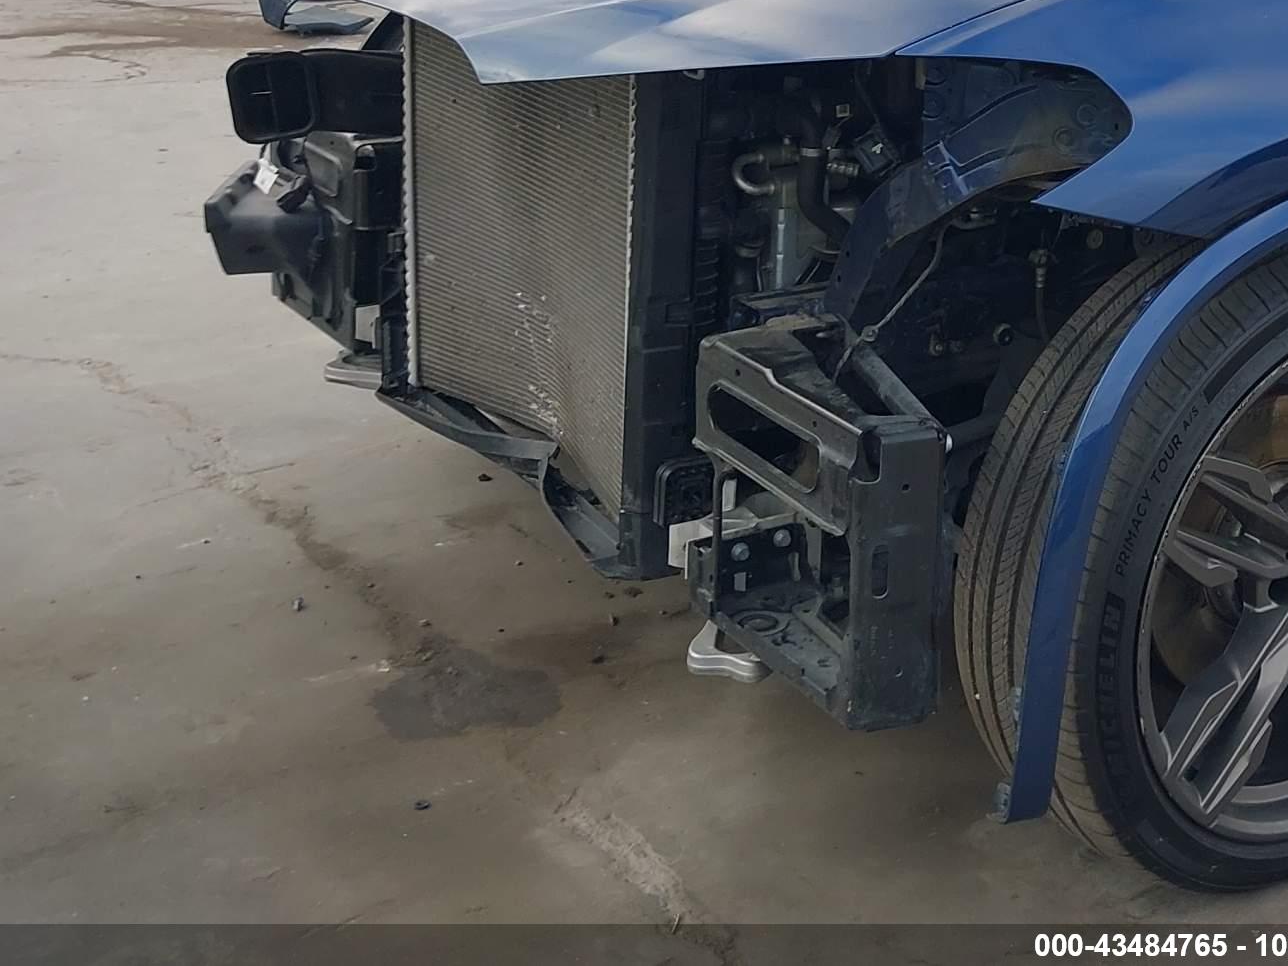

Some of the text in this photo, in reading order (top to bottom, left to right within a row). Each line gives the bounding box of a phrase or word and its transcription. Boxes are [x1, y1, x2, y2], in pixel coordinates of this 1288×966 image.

[1114, 405, 1200, 577] PRIMACY TOUR A/S
